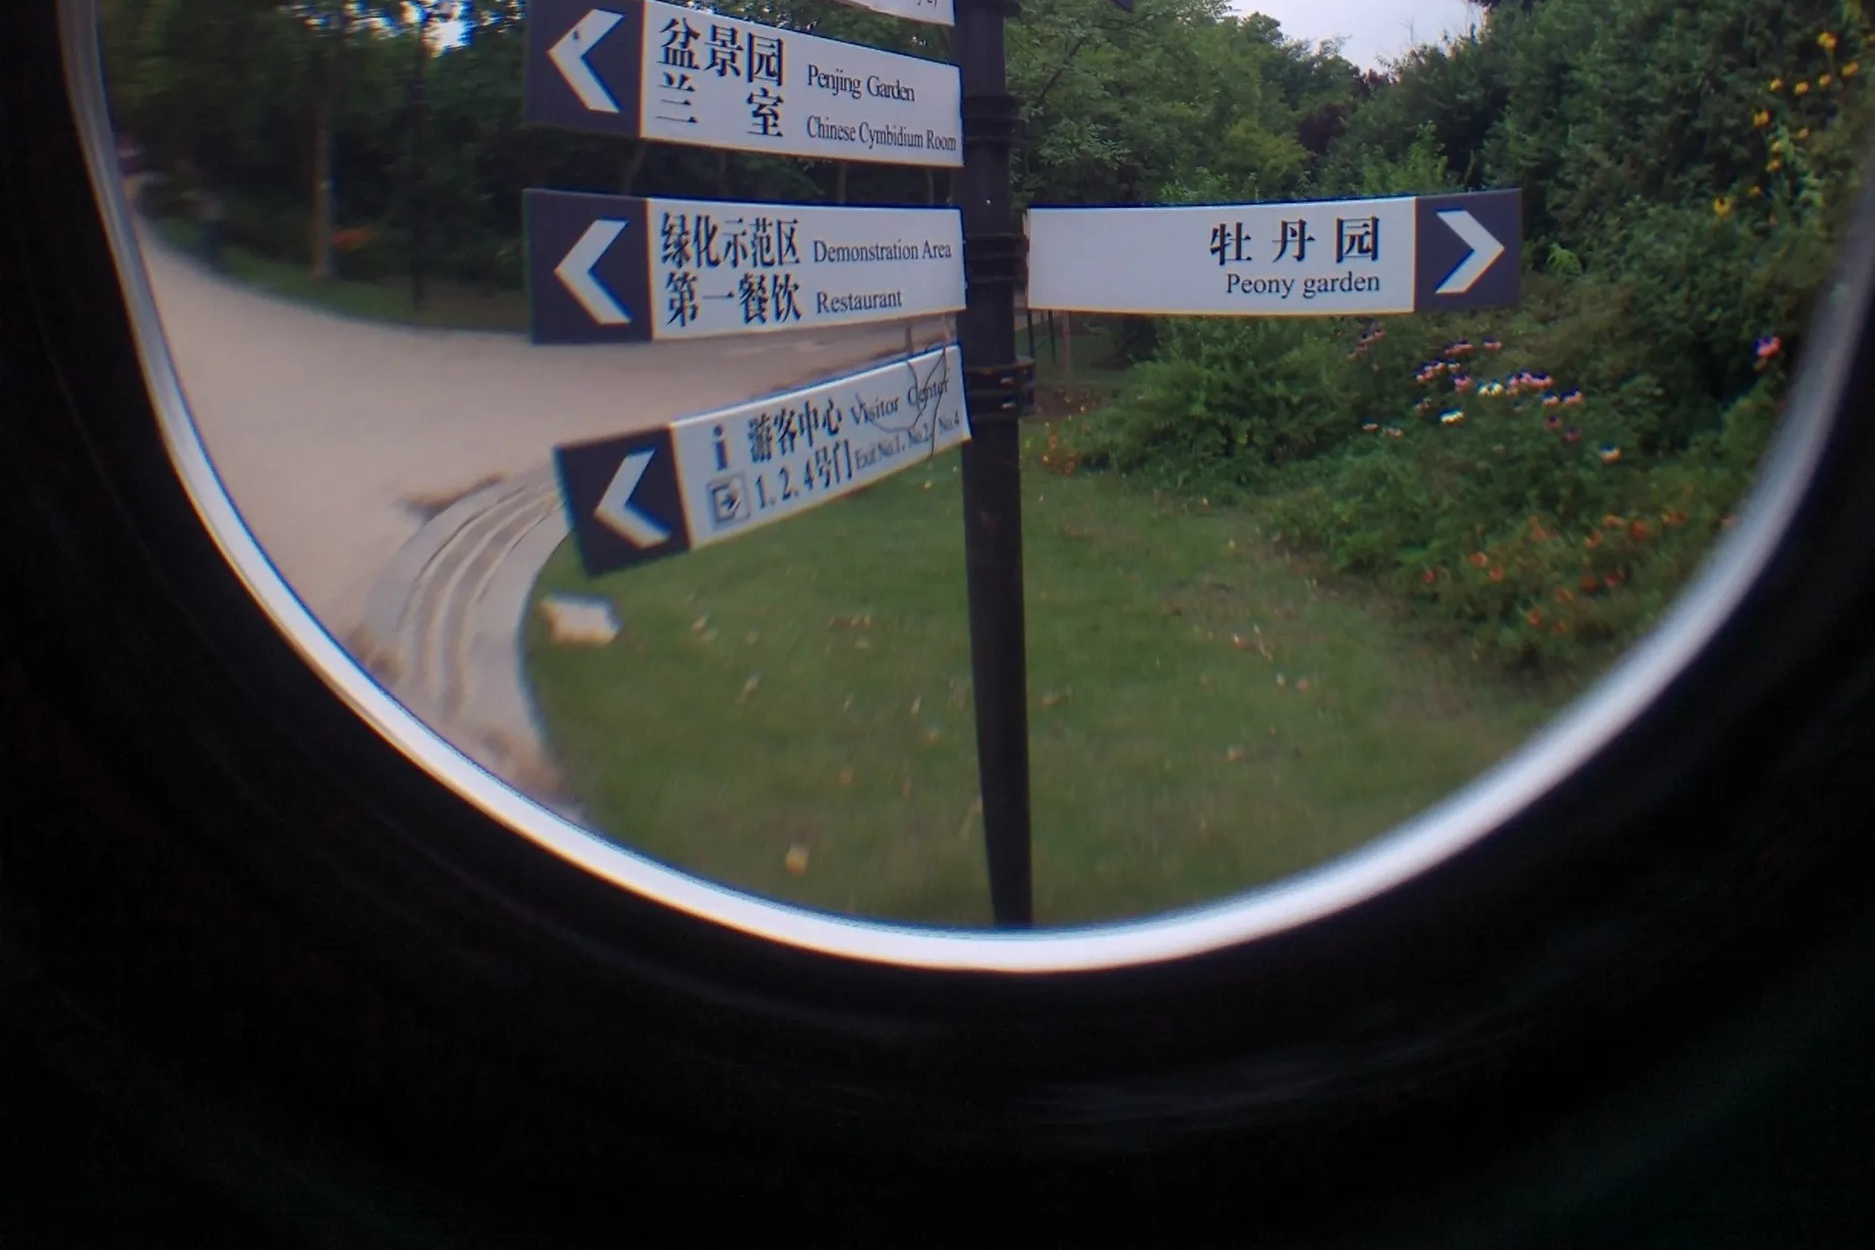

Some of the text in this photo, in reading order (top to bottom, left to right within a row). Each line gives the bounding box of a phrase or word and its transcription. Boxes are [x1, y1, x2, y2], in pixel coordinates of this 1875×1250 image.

[657, 17, 784, 86] 盆景园
[807, 63, 915, 102] Penjing Garden
[806, 115, 957, 151] Chinese Cymbidium Room
[661, 211, 801, 268] 绿化示范区
[813, 238, 952, 264] Demonstration Area
[1209, 214, 1381, 266] 牡丹园
[665, 271, 803, 327] 第一餐饮
[816, 289, 902, 315] Restaurant
[1226, 271, 1381, 299] Peony garden
[748, 398, 842, 464] 游客中心
